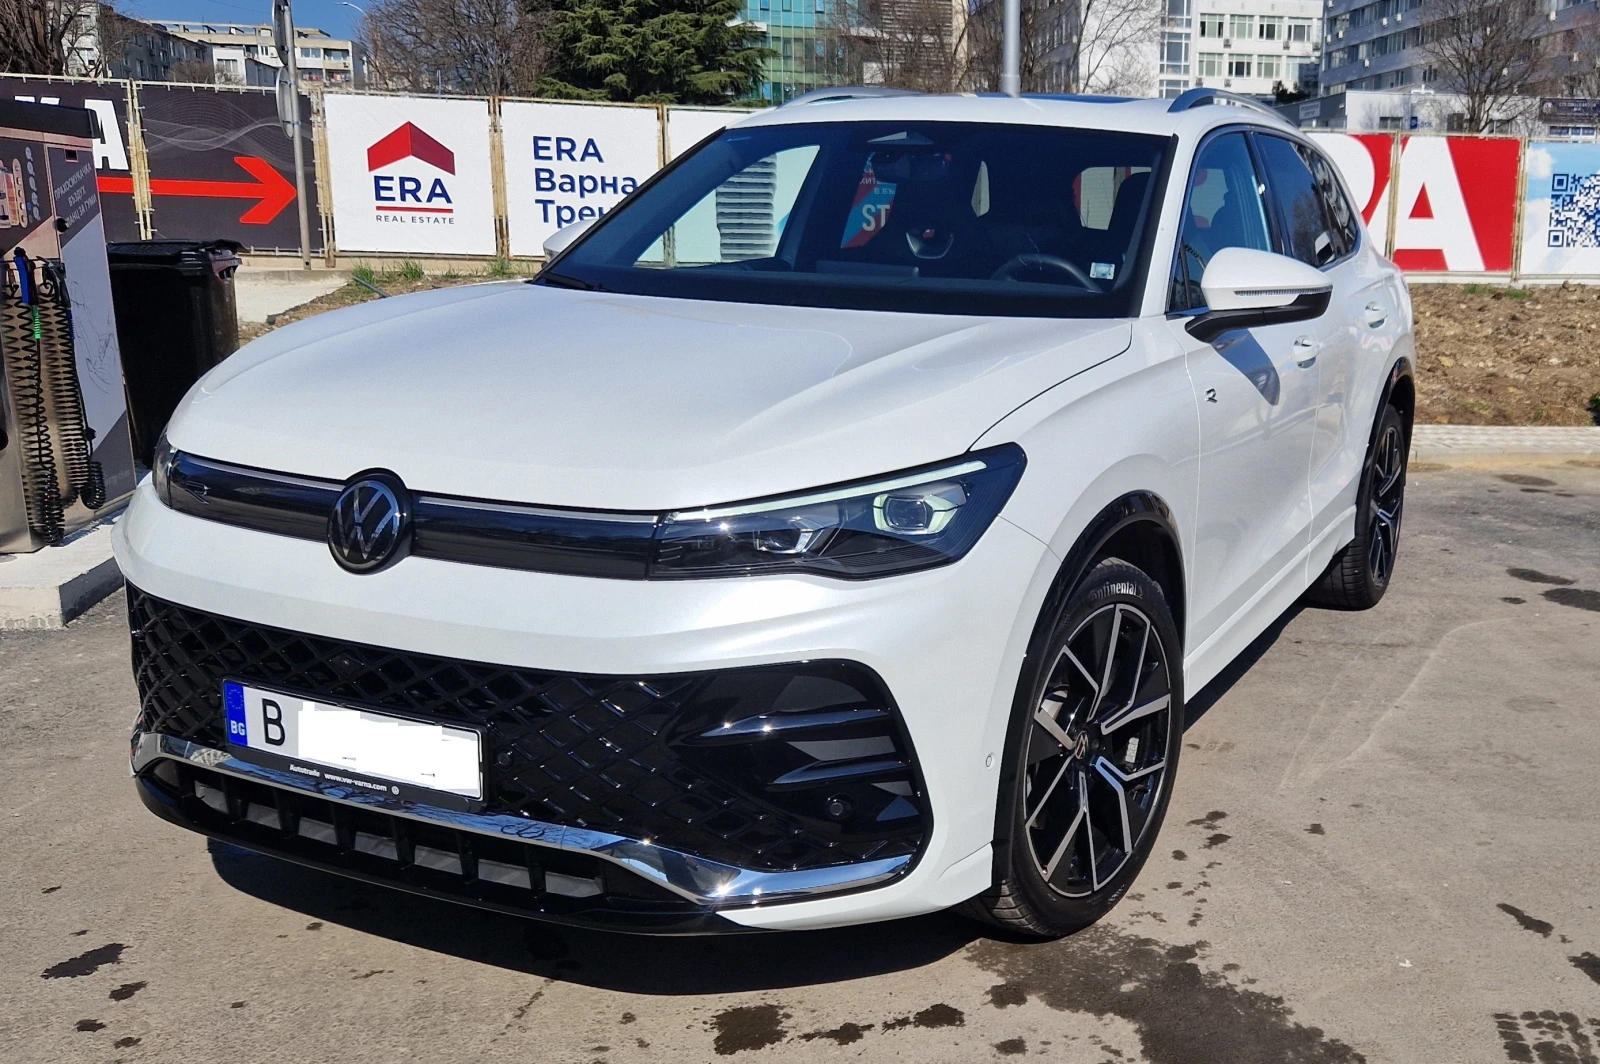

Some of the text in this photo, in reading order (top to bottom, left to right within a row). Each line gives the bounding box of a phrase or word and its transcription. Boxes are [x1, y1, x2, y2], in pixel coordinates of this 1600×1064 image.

[533, 136, 604, 163] ERA
[374, 175, 453, 204] ERA
[535, 168, 638, 199] Варна
[376, 215, 455, 225] REAL ESTATE
[230, 719, 246, 736] BG
[261, 698, 286, 746] B
